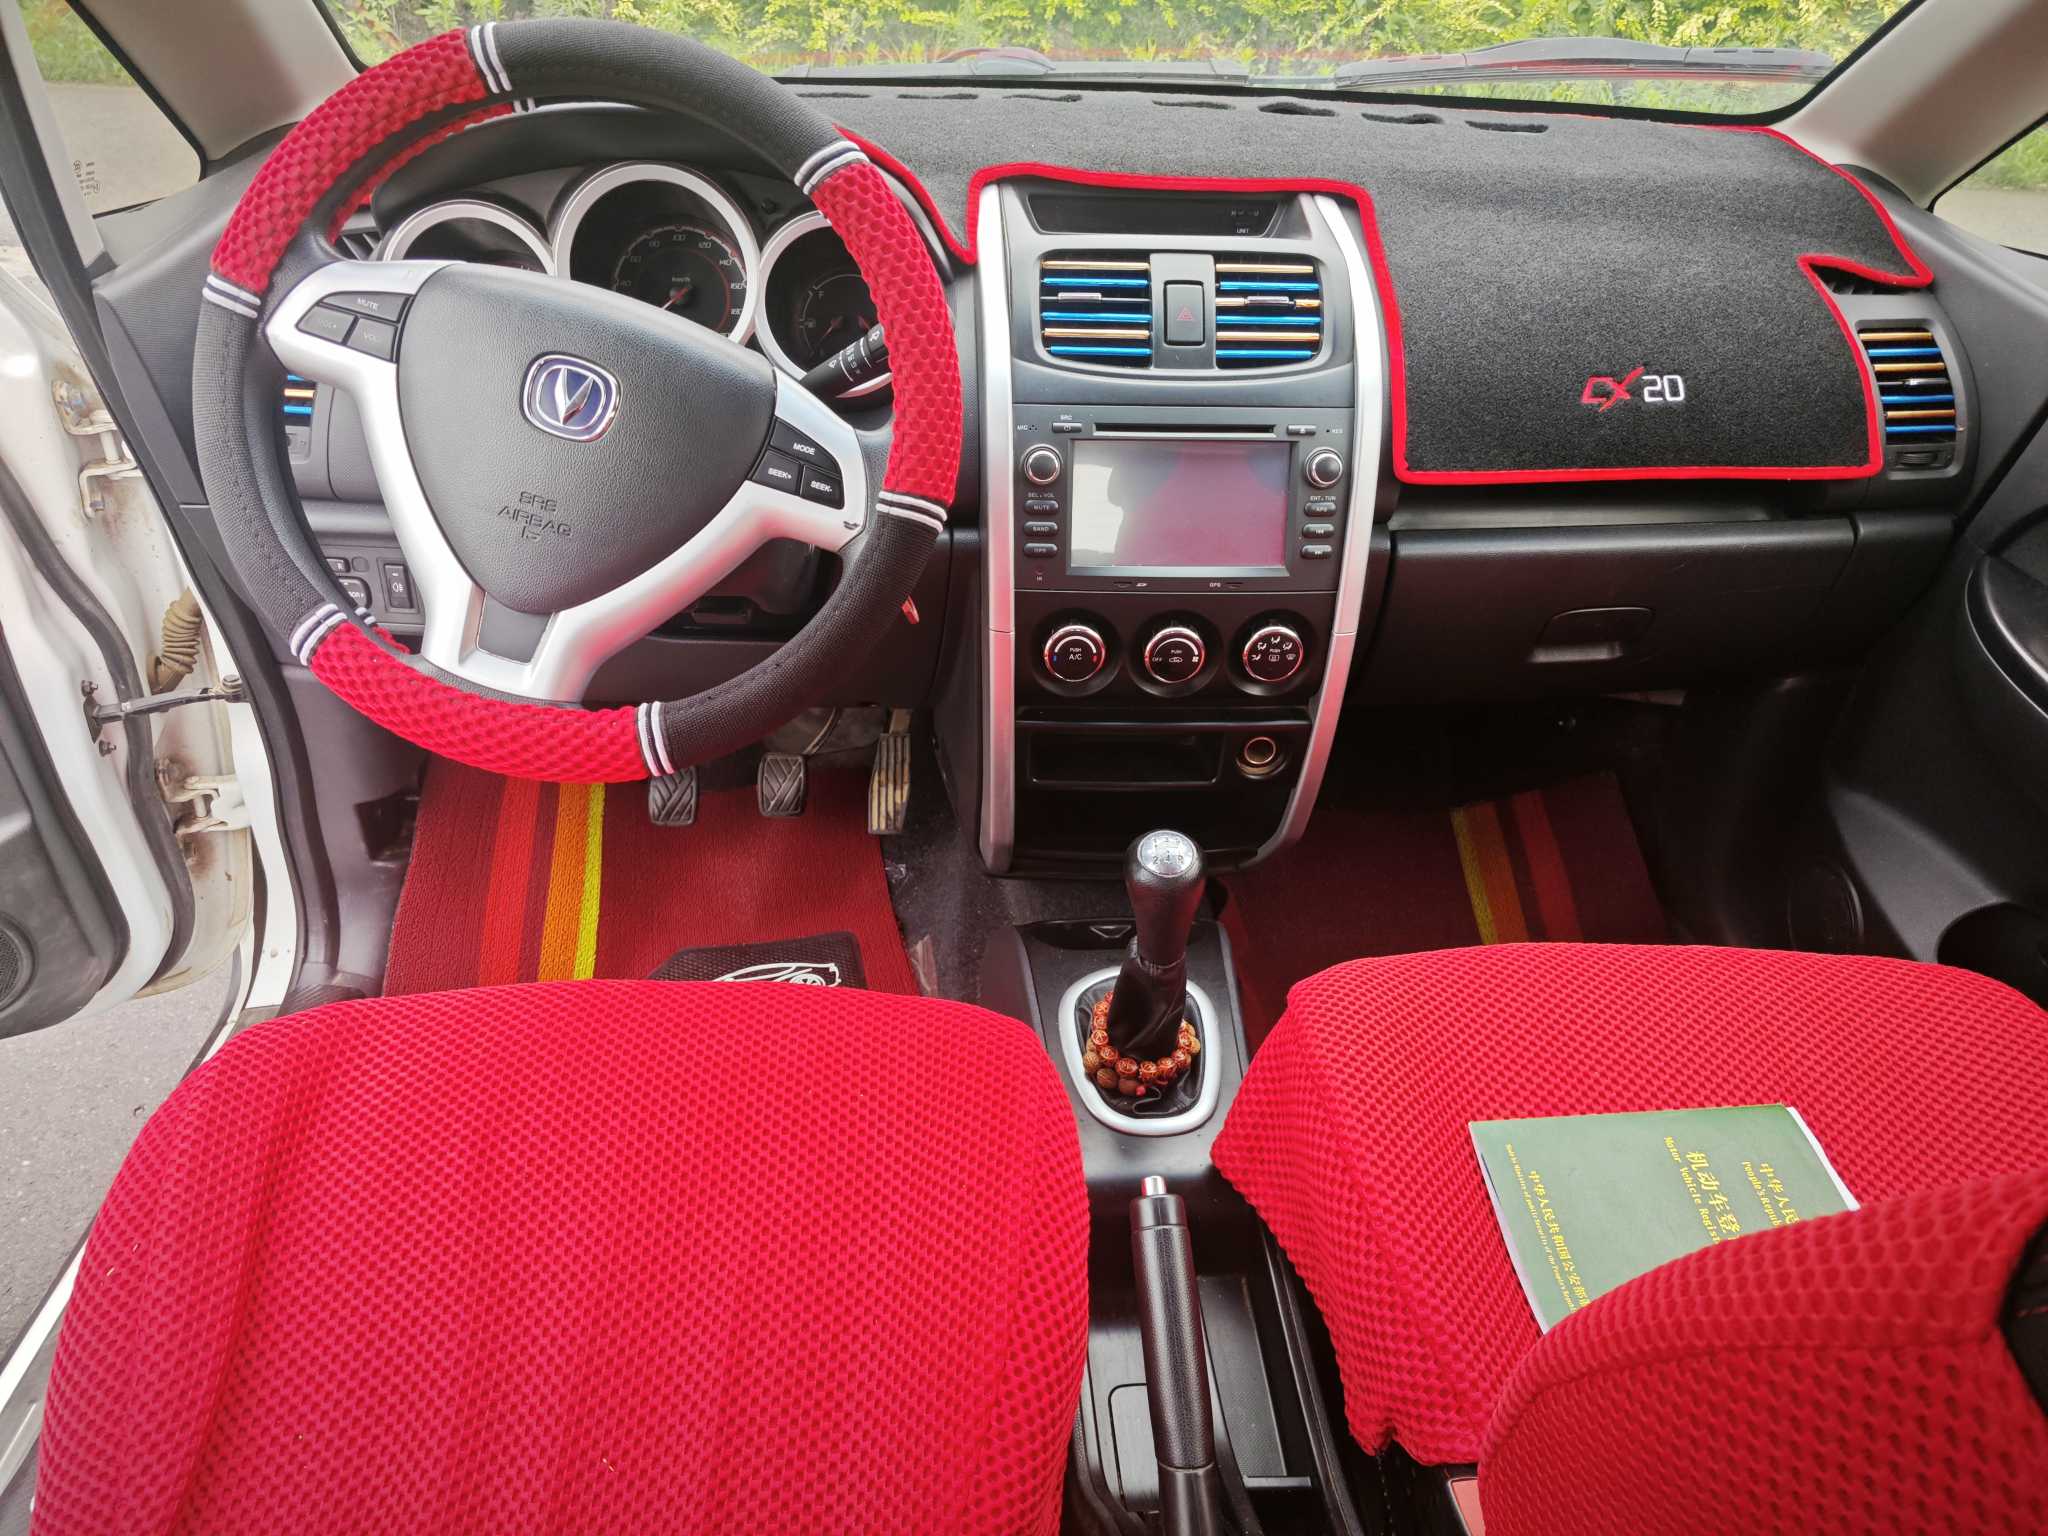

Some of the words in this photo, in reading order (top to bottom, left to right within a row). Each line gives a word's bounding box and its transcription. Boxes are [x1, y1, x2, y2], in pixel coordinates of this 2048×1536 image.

[792, 442, 816, 456] MODE
[519, 491, 557, 512] SRS
[497, 505, 572, 537] AIRBAG
[1068, 653, 1082, 661] A/C
[1685, 1151, 1743, 1240] 机动车登
